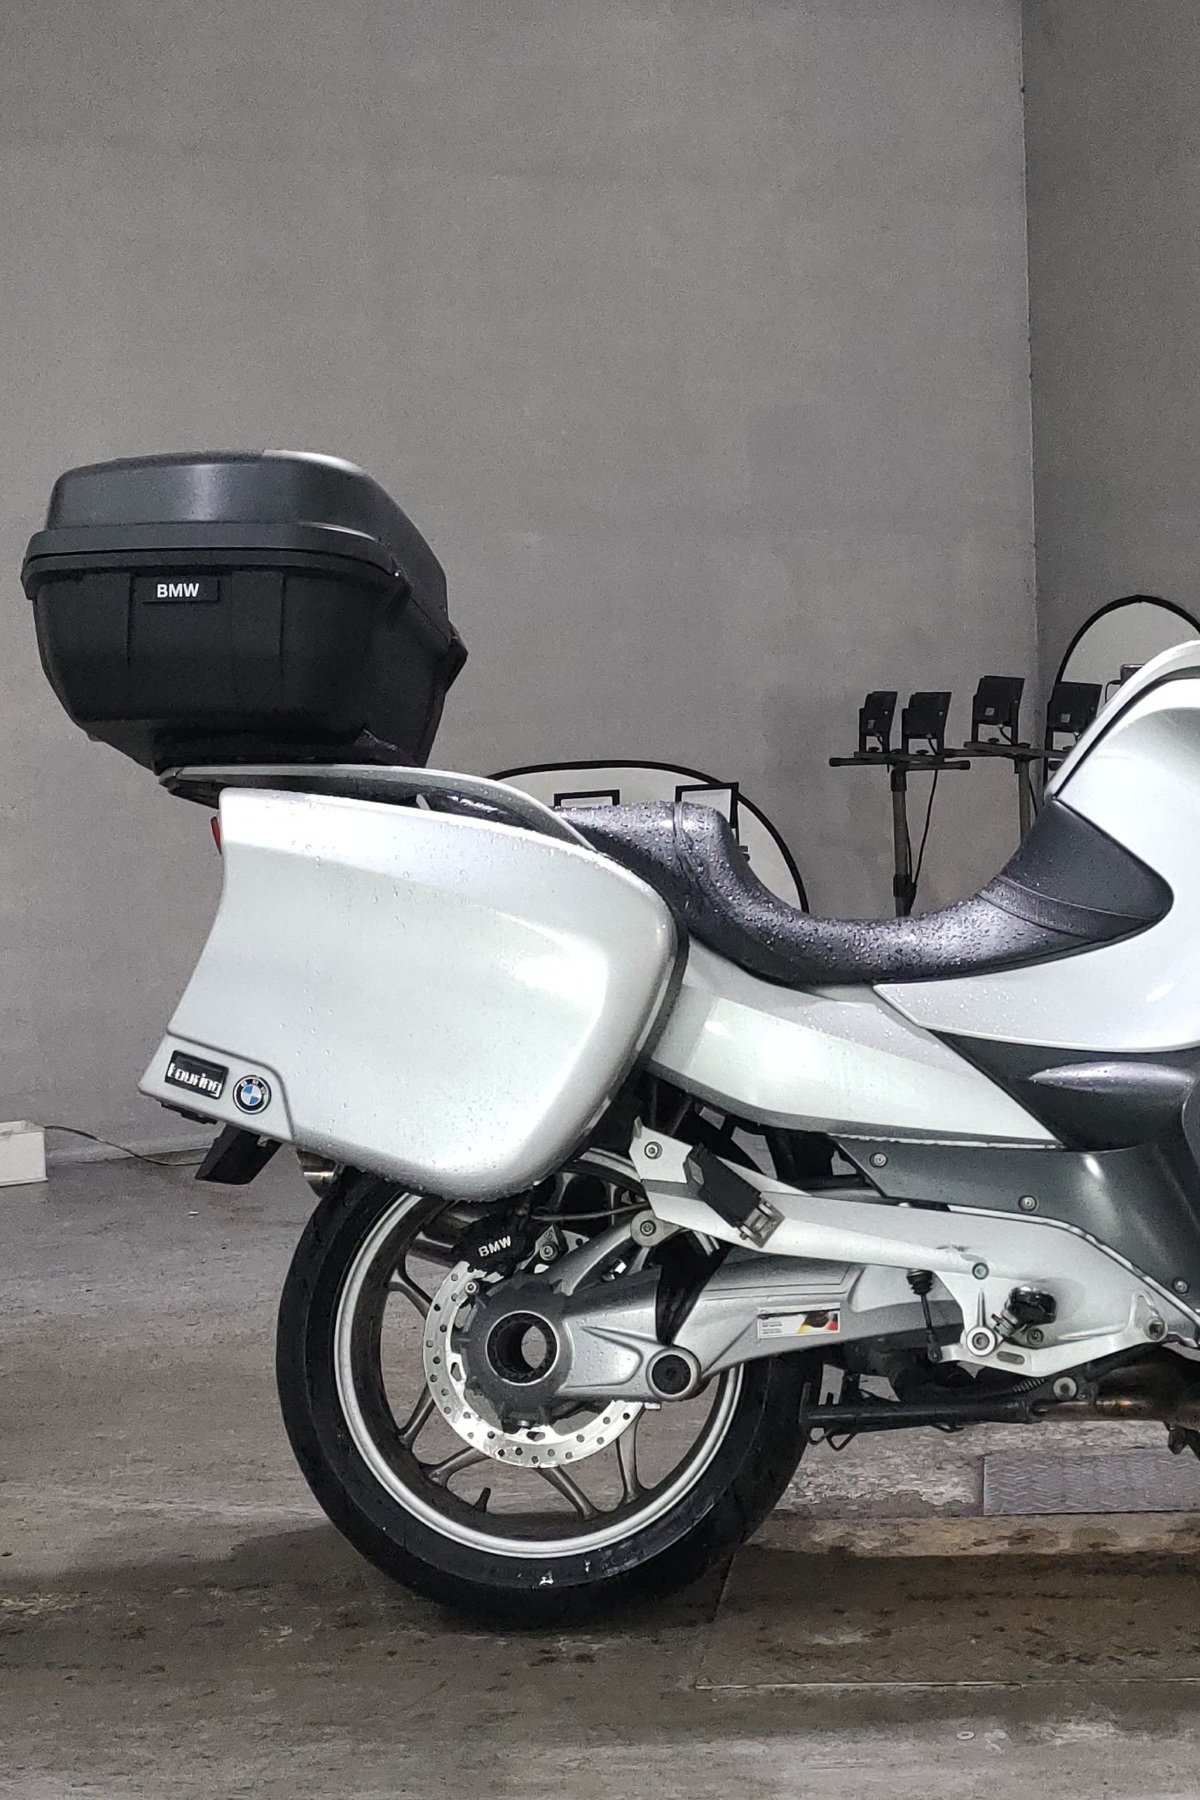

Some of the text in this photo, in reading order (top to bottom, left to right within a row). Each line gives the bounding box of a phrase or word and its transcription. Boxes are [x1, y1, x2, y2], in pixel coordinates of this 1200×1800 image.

[157, 583, 199, 598] BMW
[167, 1062, 222, 1098] touring
[478, 1235, 511, 1257] BMW
